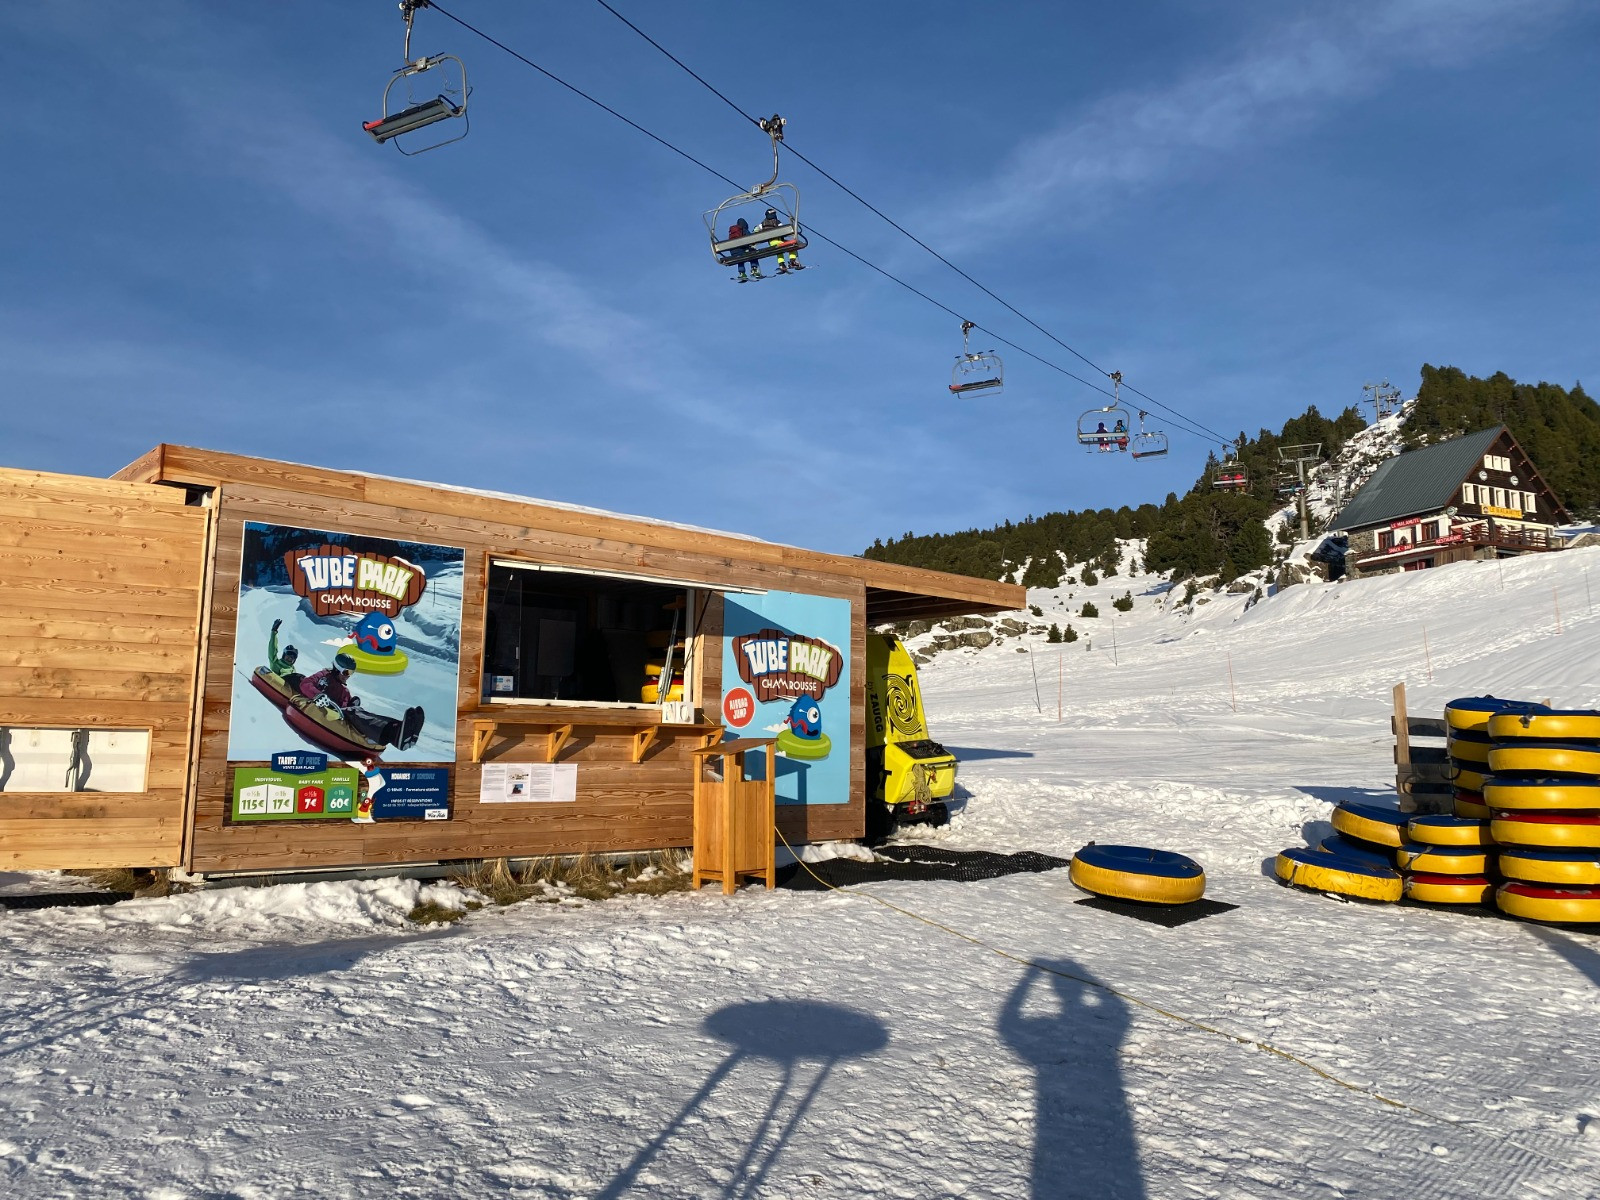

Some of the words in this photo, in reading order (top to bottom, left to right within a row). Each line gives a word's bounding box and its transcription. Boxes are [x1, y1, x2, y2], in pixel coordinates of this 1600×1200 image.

[299, 556, 356, 590] TUBE
[358, 558, 413, 599] PARK
[320, 593, 392, 609] CHAMROUSSE
[744, 639, 788, 675] TUBE
[790, 642, 832, 681] PARK
[761, 677, 817, 692] CHAMROUSSE
[870, 693, 884, 733] ZAUGG
[277, 756, 297, 766] TARIFS
[305, 756, 321, 765] PRICE
[272, 799, 290, 810] 17€
[304, 798, 317, 810] 7€
[330, 798, 350, 809] 60€
